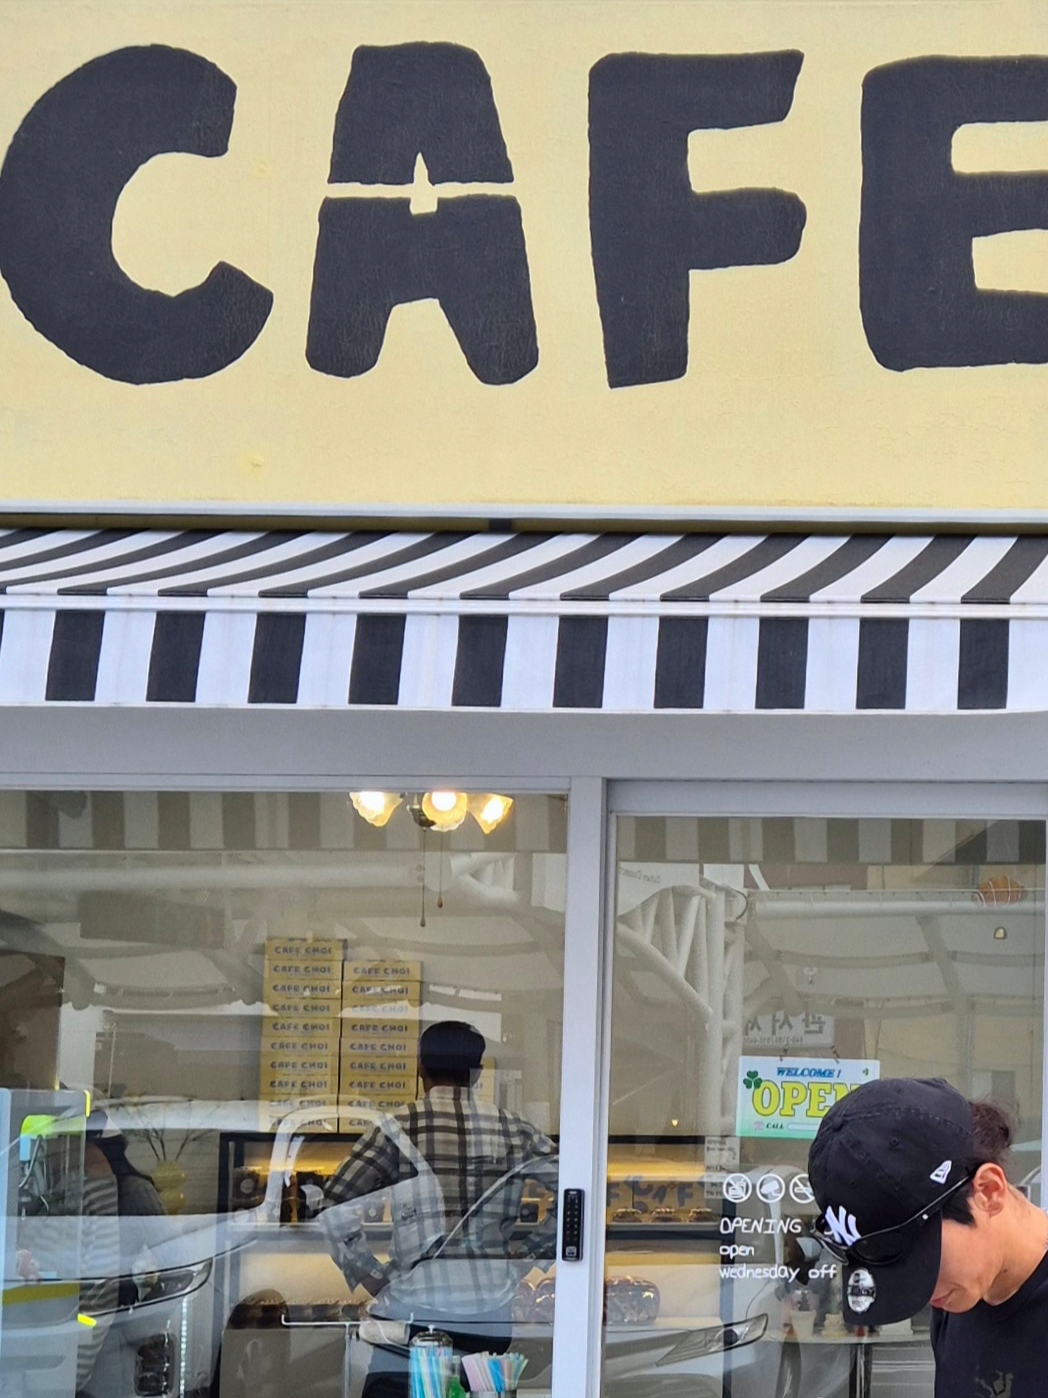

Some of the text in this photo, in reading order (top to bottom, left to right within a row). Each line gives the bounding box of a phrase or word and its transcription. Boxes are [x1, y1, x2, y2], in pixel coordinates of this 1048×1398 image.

[766, 1122, 785, 1130] CALL
[719, 1216, 802, 1235] OPENING
[719, 1245, 755, 1260] open
[719, 1263, 838, 1284] wednesday off
